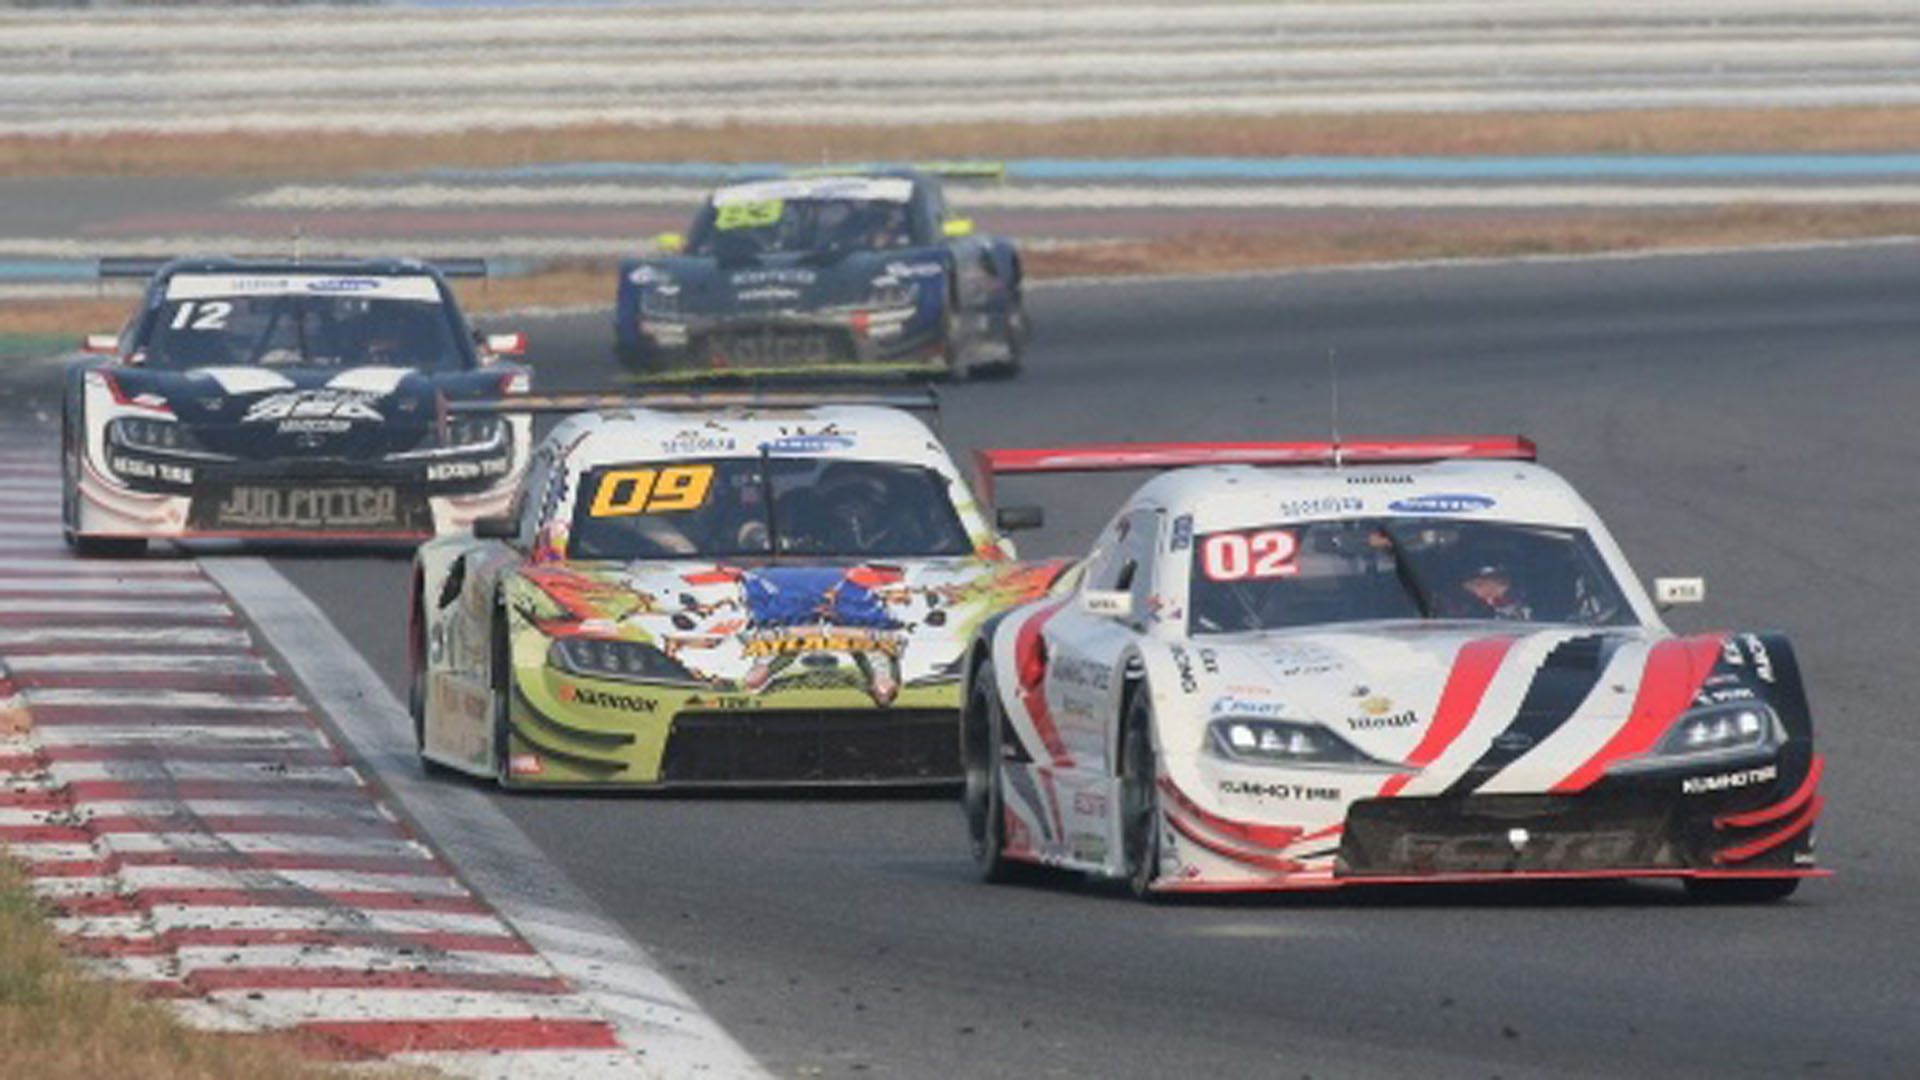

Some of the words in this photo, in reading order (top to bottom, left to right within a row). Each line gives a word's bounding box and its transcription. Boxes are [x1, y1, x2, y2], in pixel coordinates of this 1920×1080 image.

[171, 302, 233, 330] 12
[589, 464, 715, 517] 09
[1204, 530, 1300, 580] 02
